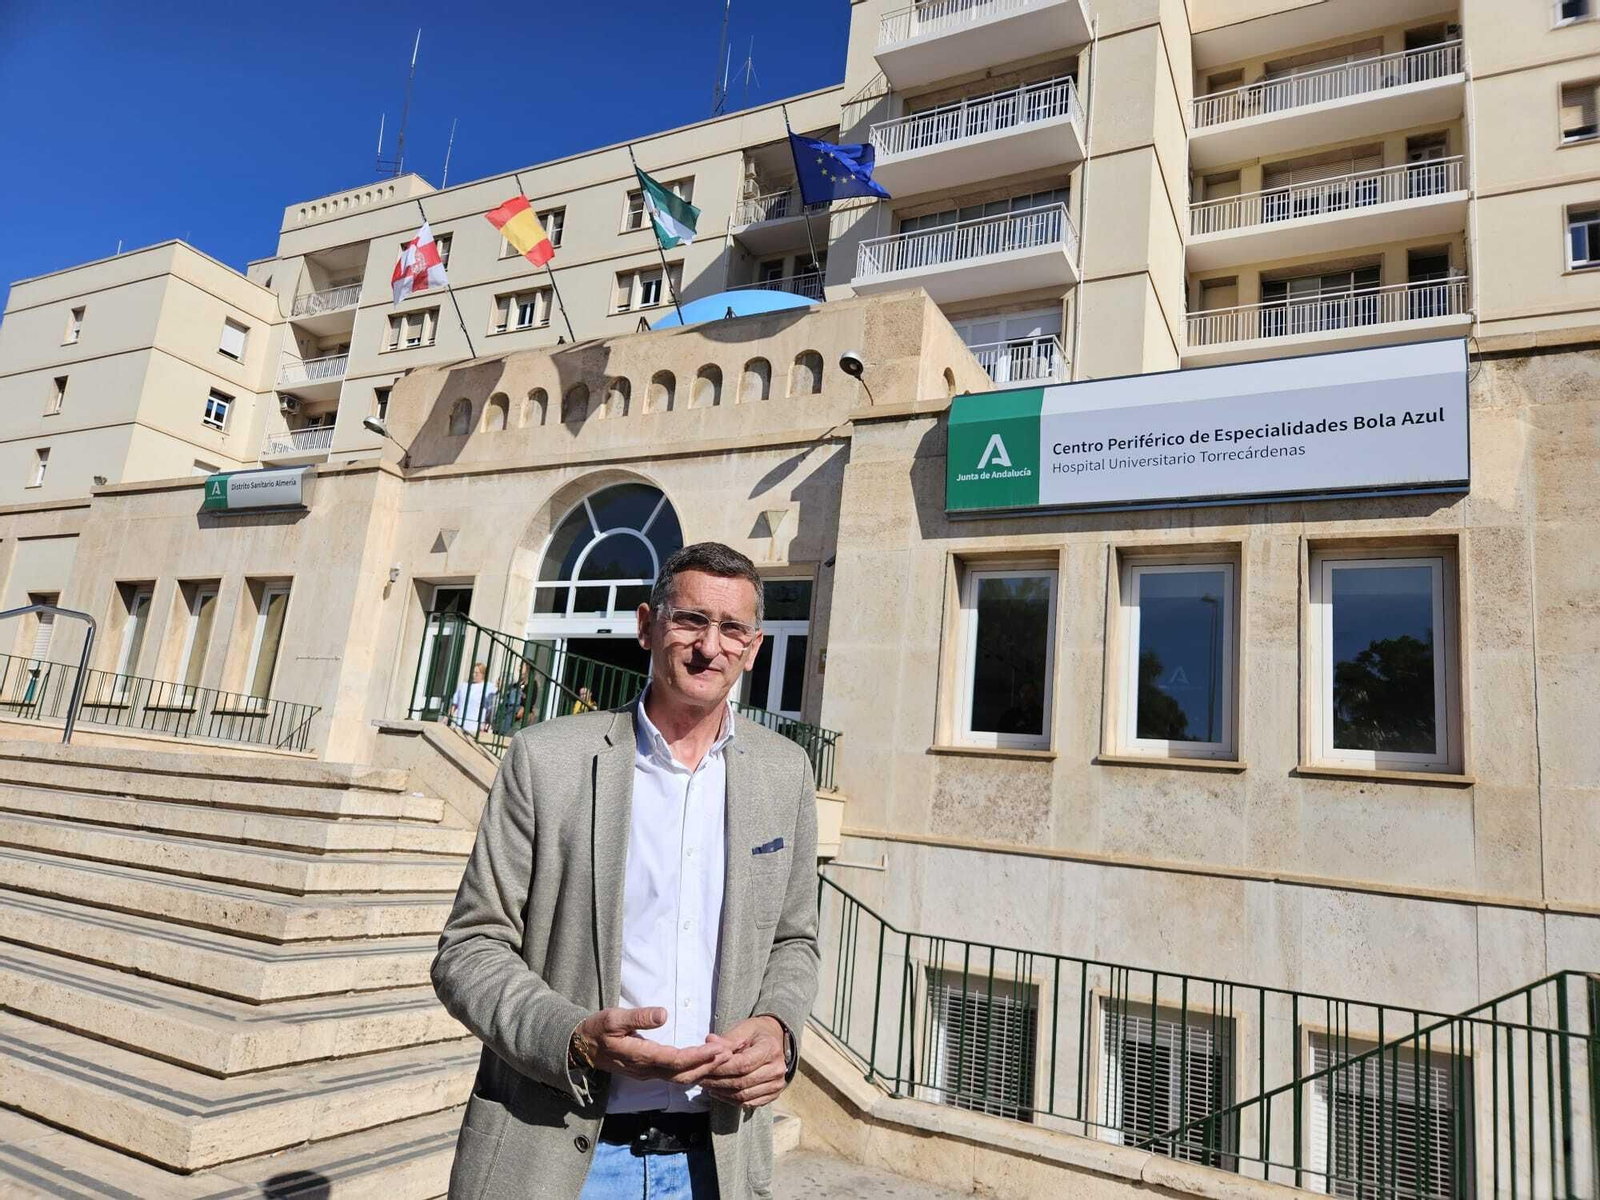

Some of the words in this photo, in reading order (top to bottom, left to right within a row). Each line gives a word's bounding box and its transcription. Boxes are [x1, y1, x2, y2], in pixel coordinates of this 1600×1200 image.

[1052, 440, 1104, 456] Centro
[1107, 432, 1185, 451] Periférico
[1189, 430, 1210, 444] de
[1214, 418, 1348, 443] Especialidades
[1353, 413, 1396, 430] Bola
[1401, 407, 1445, 426] Azul
[1052, 459, 1105, 475] Hospital
[1108, 452, 1196, 470] Universitario
[1200, 445, 1306, 463] Torrecárdenas
[231, 482, 250, 491] Distrito
[251, 480, 274, 489] Sanitario
[275, 478, 297, 487] Almería
[956, 473, 979, 482] Junta
[980, 471, 990, 480] de
[991, 467, 1031, 479] Andalucía
